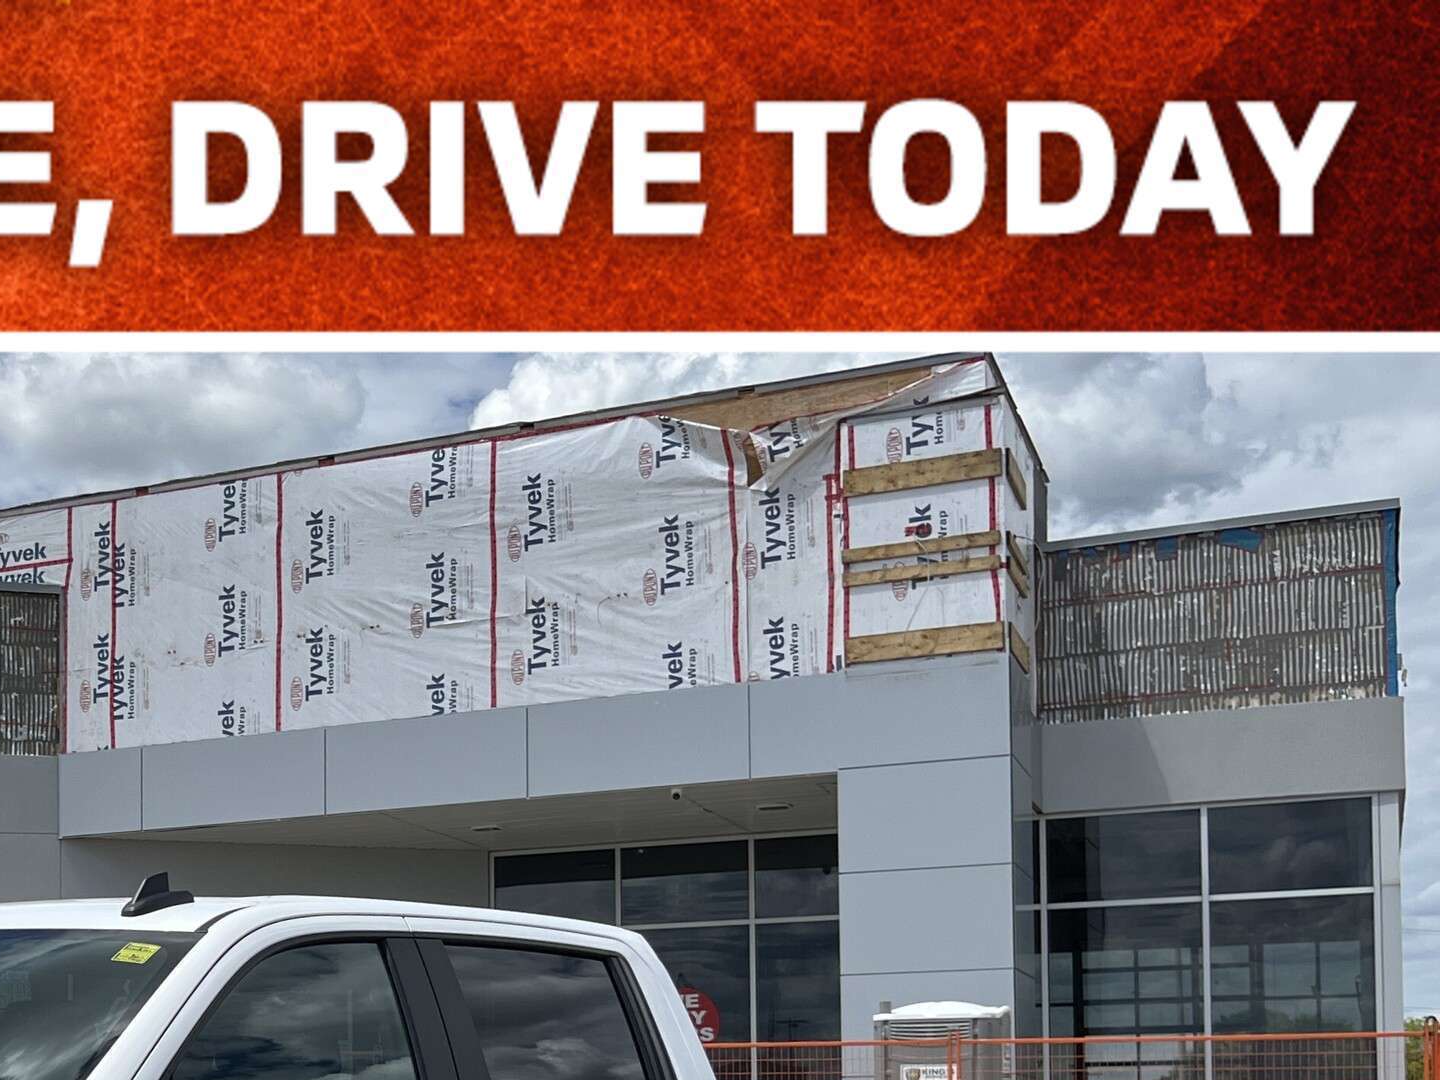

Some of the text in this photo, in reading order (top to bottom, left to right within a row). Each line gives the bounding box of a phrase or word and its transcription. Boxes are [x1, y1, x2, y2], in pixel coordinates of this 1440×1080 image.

[426, 448, 448, 507] Tyve
[219, 480, 239, 542] Tyve
[522, 473, 548, 552] Tyvek
[546, 479, 556, 543] HomeWrap
[759, 488, 786, 569] Tyvek
[786, 494, 796, 560] HomeWrap
[94, 521, 111, 591] Tyvek
[128, 549, 137, 606] HomeWrap
[306, 510, 327, 584] Tyvek
[327, 516, 336, 576] HomeWrap
[658, 514, 685, 595] Tyvek
[685, 521, 694, 586] HomeWrap
[218, 584, 239, 657] Tyvek
[239, 591, 247, 650] HomeWrap
[426, 552, 448, 628] Tyvek
[305, 628, 327, 701] Tyvek
[327, 634, 336, 694] HomeWrap
[526, 597, 551, 675] Tyvek
[550, 602, 560, 667] HomeWrap
[662, 641, 683, 689] vek
[763, 616, 790, 679] yvek
[93, 633, 111, 704] Tyvek
[128, 662, 136, 719] HomeWrap
